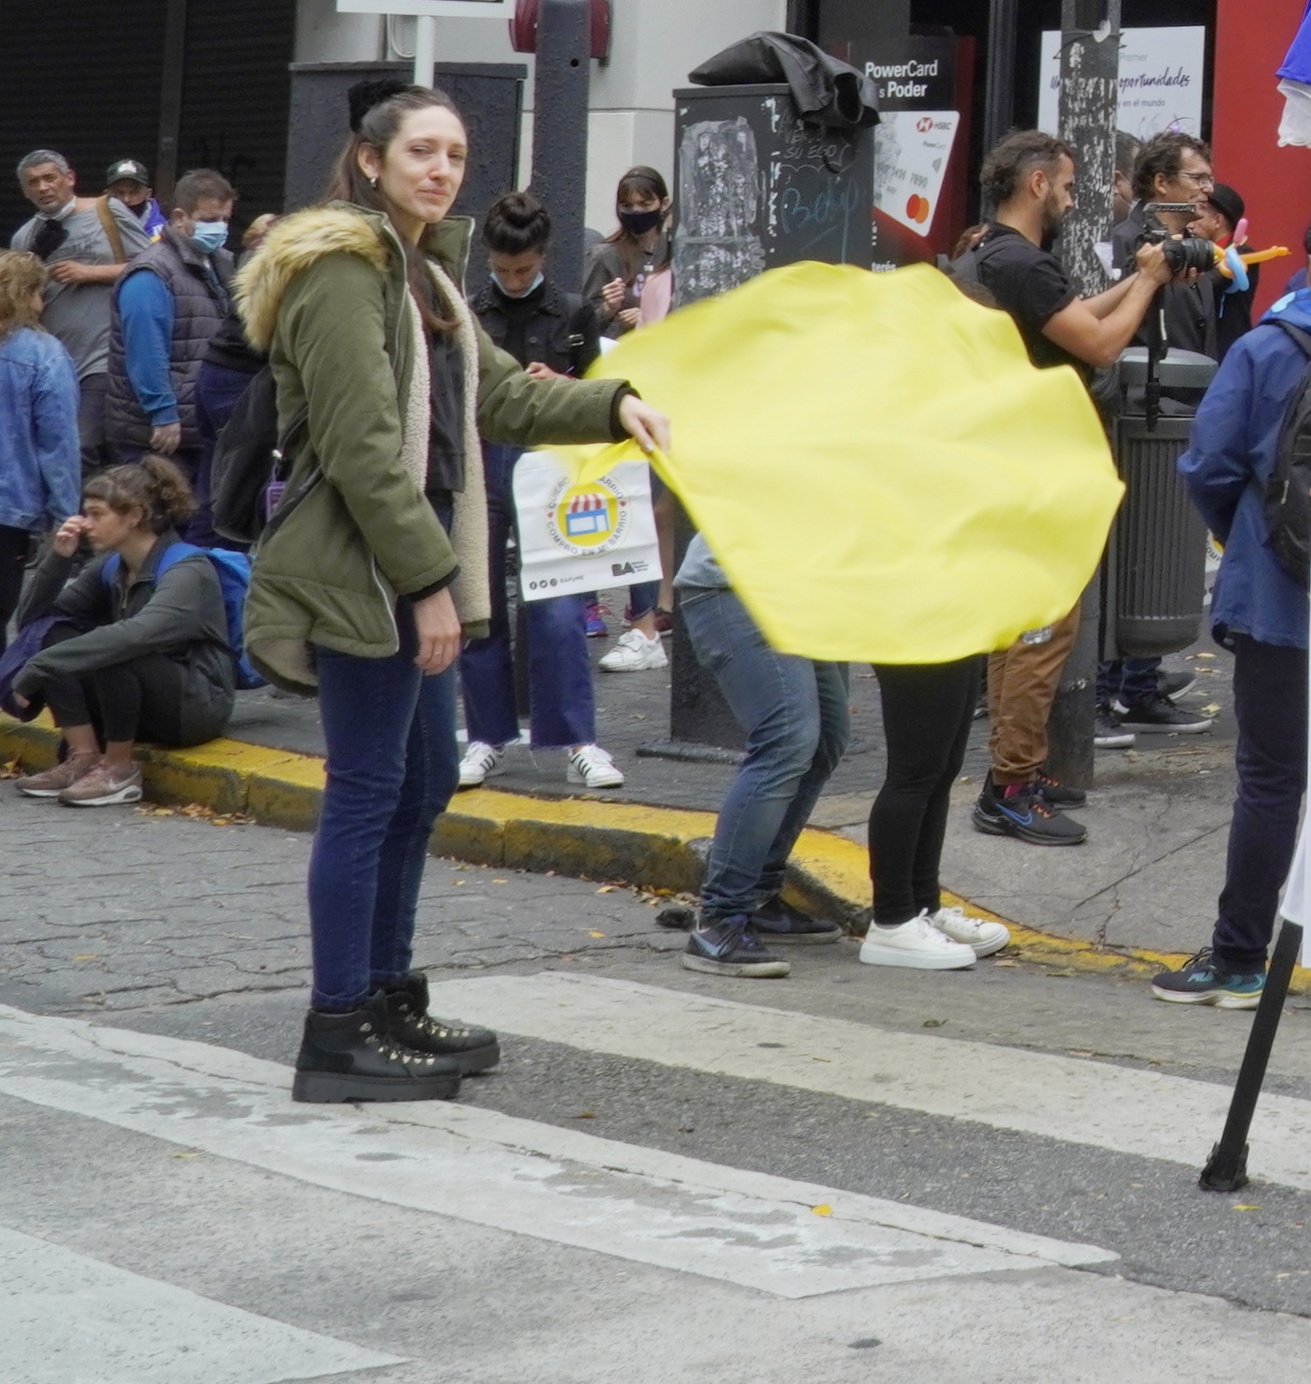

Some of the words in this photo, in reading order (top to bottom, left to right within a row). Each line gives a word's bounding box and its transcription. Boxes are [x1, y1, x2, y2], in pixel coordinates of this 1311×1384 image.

[865, 59, 938, 78] PowerCard
[887, 80, 928, 98] Poder
[1119, 66, 1191, 94] oportunidades
[1133, 98, 1140, 107] el
[1145, 98, 1166, 107] mundo
[547, 521, 578, 555] COMPRO
[608, 510, 628, 545] BARRIO
[611, 562, 635, 576] BA
